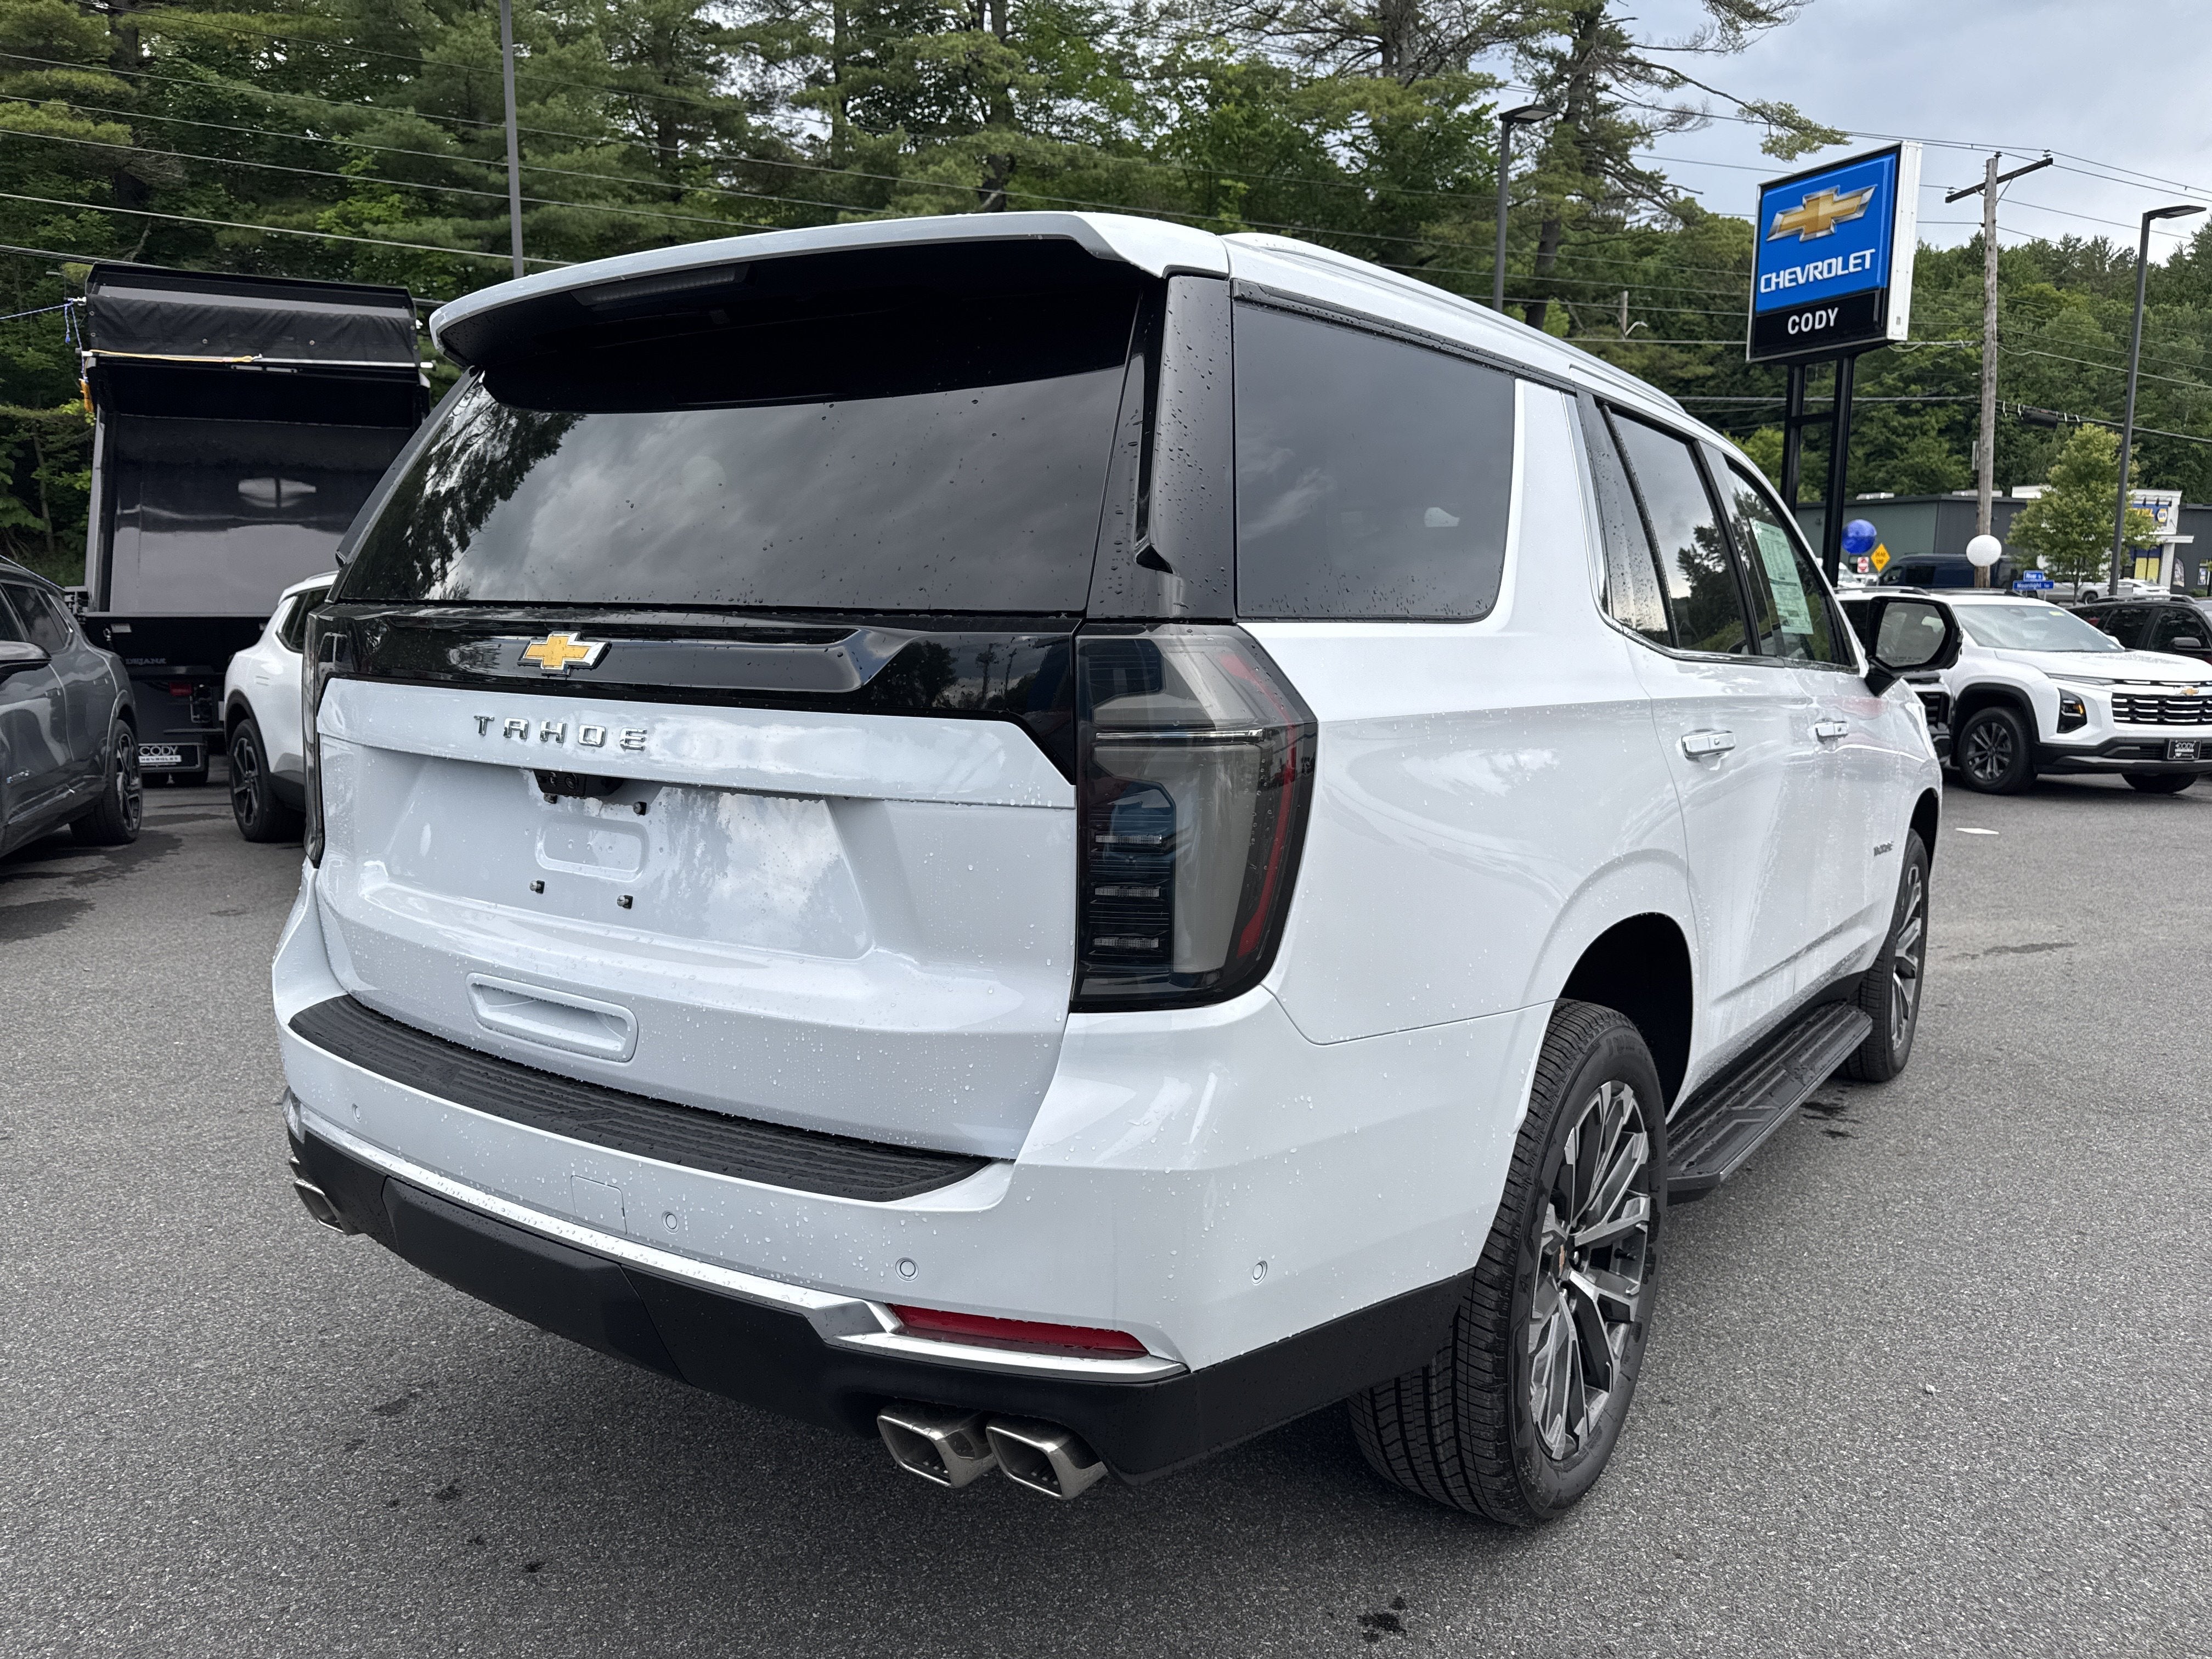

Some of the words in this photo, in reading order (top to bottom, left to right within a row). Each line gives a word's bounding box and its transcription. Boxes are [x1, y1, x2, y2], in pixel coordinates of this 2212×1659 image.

[1760, 249, 1876, 294] CHEVROLET
[1787, 307, 1839, 335] CODY
[473, 715, 647, 752] TAHOE
[139, 746, 178, 756] CODY
